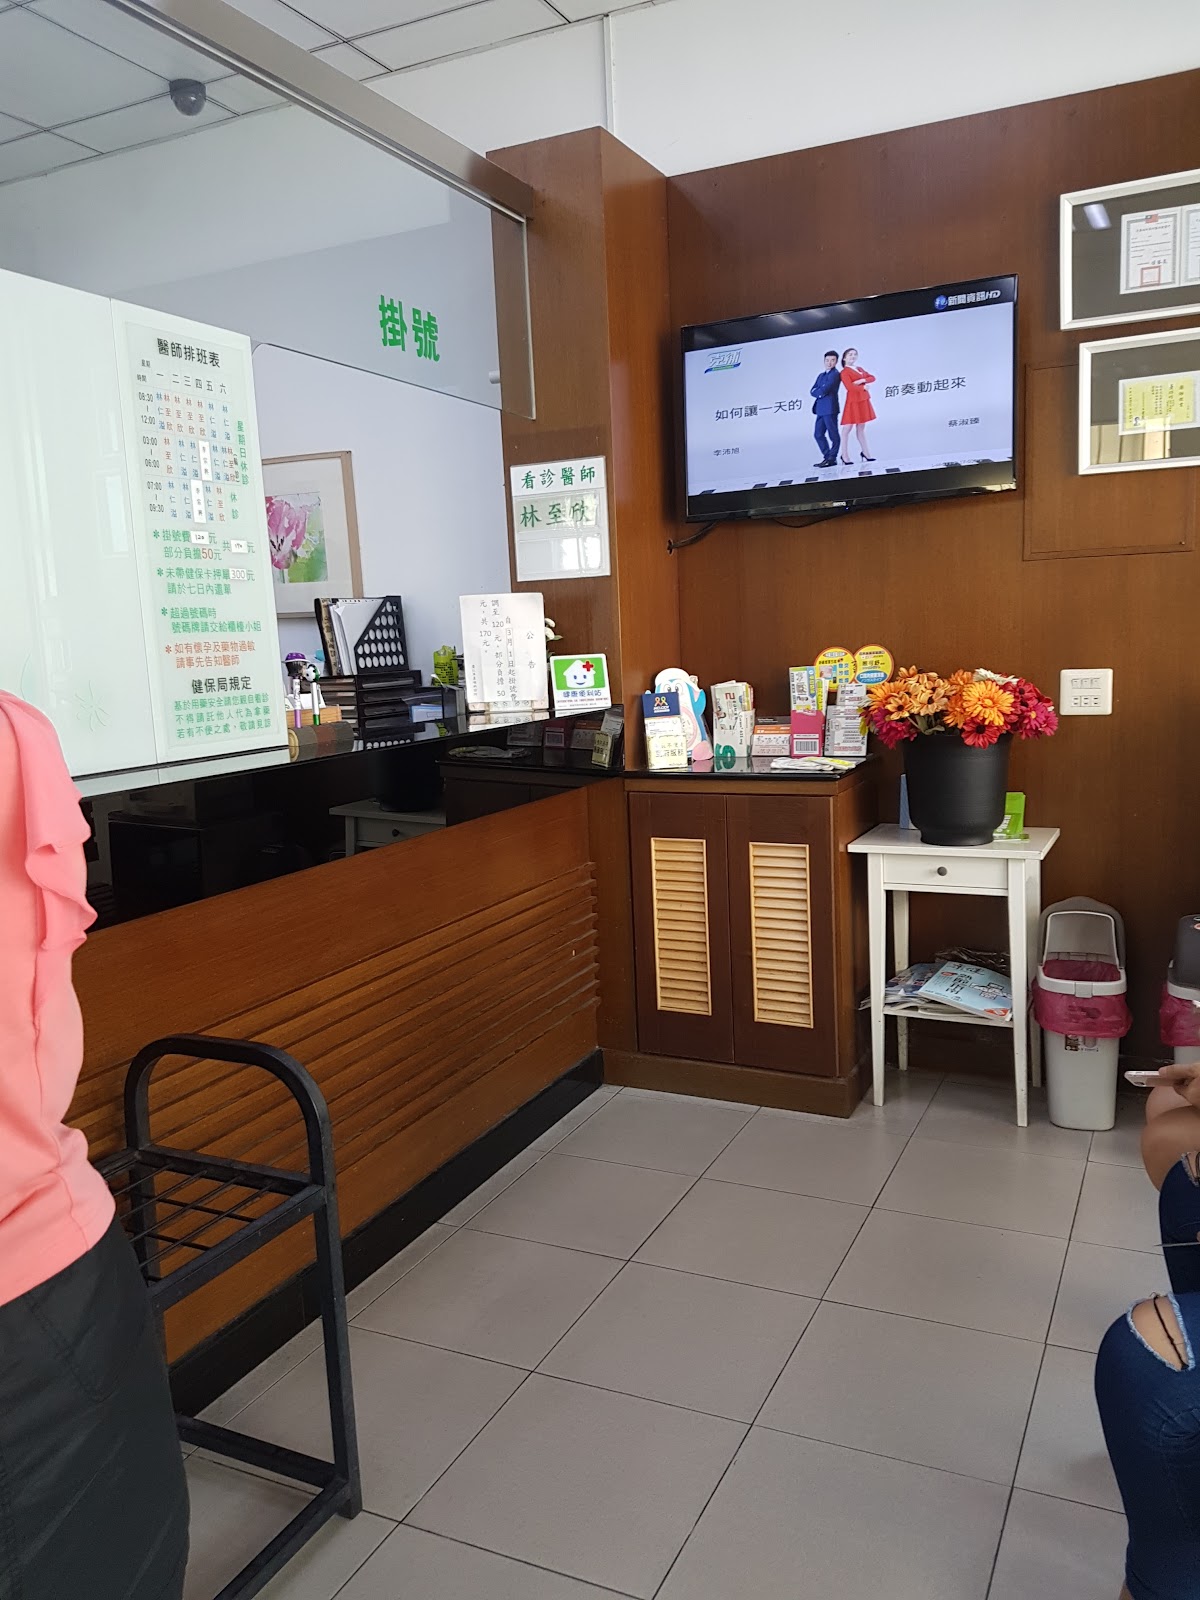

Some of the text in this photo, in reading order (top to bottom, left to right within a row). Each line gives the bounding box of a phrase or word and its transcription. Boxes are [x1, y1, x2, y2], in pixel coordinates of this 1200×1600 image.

[379, 294, 440, 362] 掛號
[157, 337, 220, 368] 醫師排班表
[195, 378, 203, 389] 四
[206, 380, 213, 392] 五
[884, 376, 966, 398] 節奏動起來
[715, 399, 802, 421] 如何讓一天的
[521, 465, 596, 489] 看診醫師
[520, 500, 592, 528] 林至欣
[192, 676, 252, 694] 健保局規定
